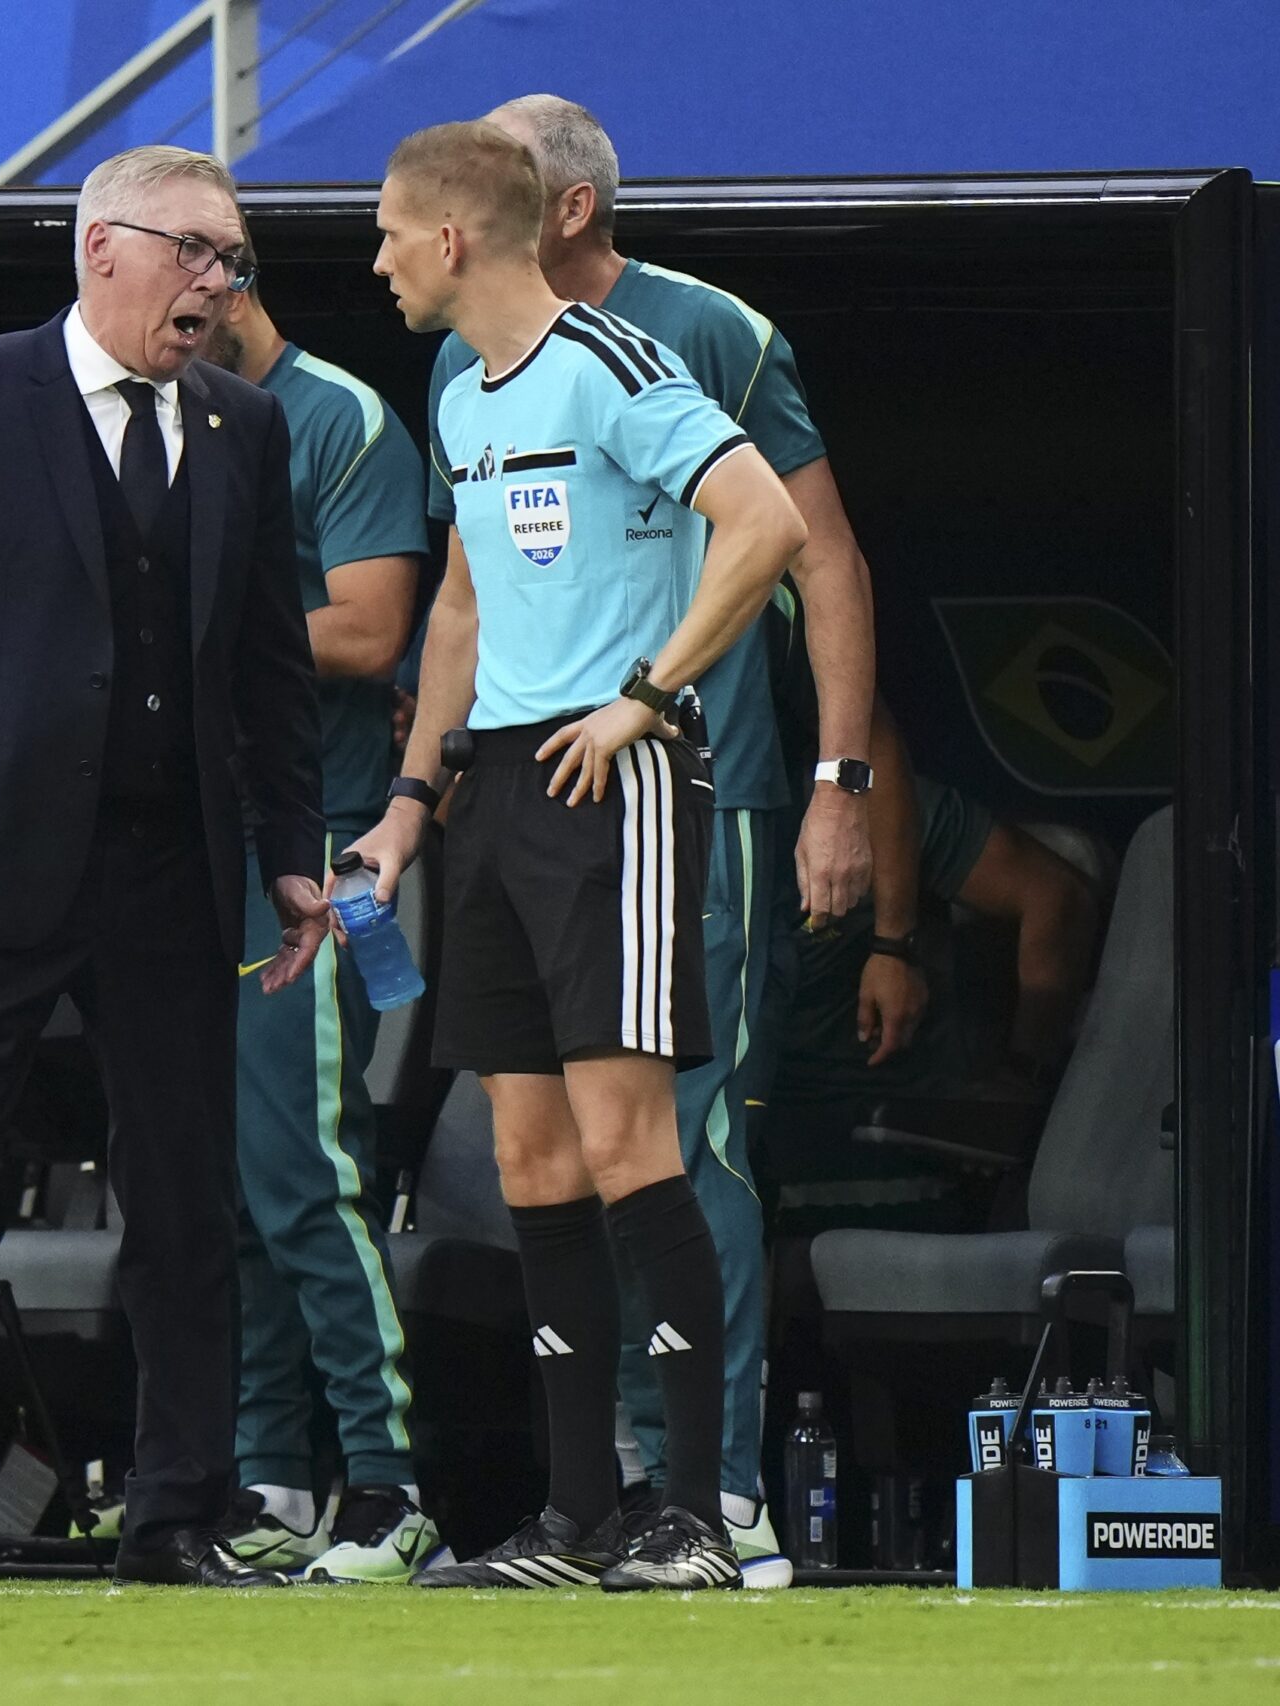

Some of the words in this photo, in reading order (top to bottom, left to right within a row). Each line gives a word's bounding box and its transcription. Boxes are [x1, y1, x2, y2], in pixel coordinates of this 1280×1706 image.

[510, 488, 561, 510] FIFA
[514, 521, 564, 534] REFEREE
[625, 528, 673, 541] Rexona
[531, 549, 555, 560] 2026
[1095, 1419, 1108, 1429] 21
[1093, 1522, 1215, 1549] POWERADE
